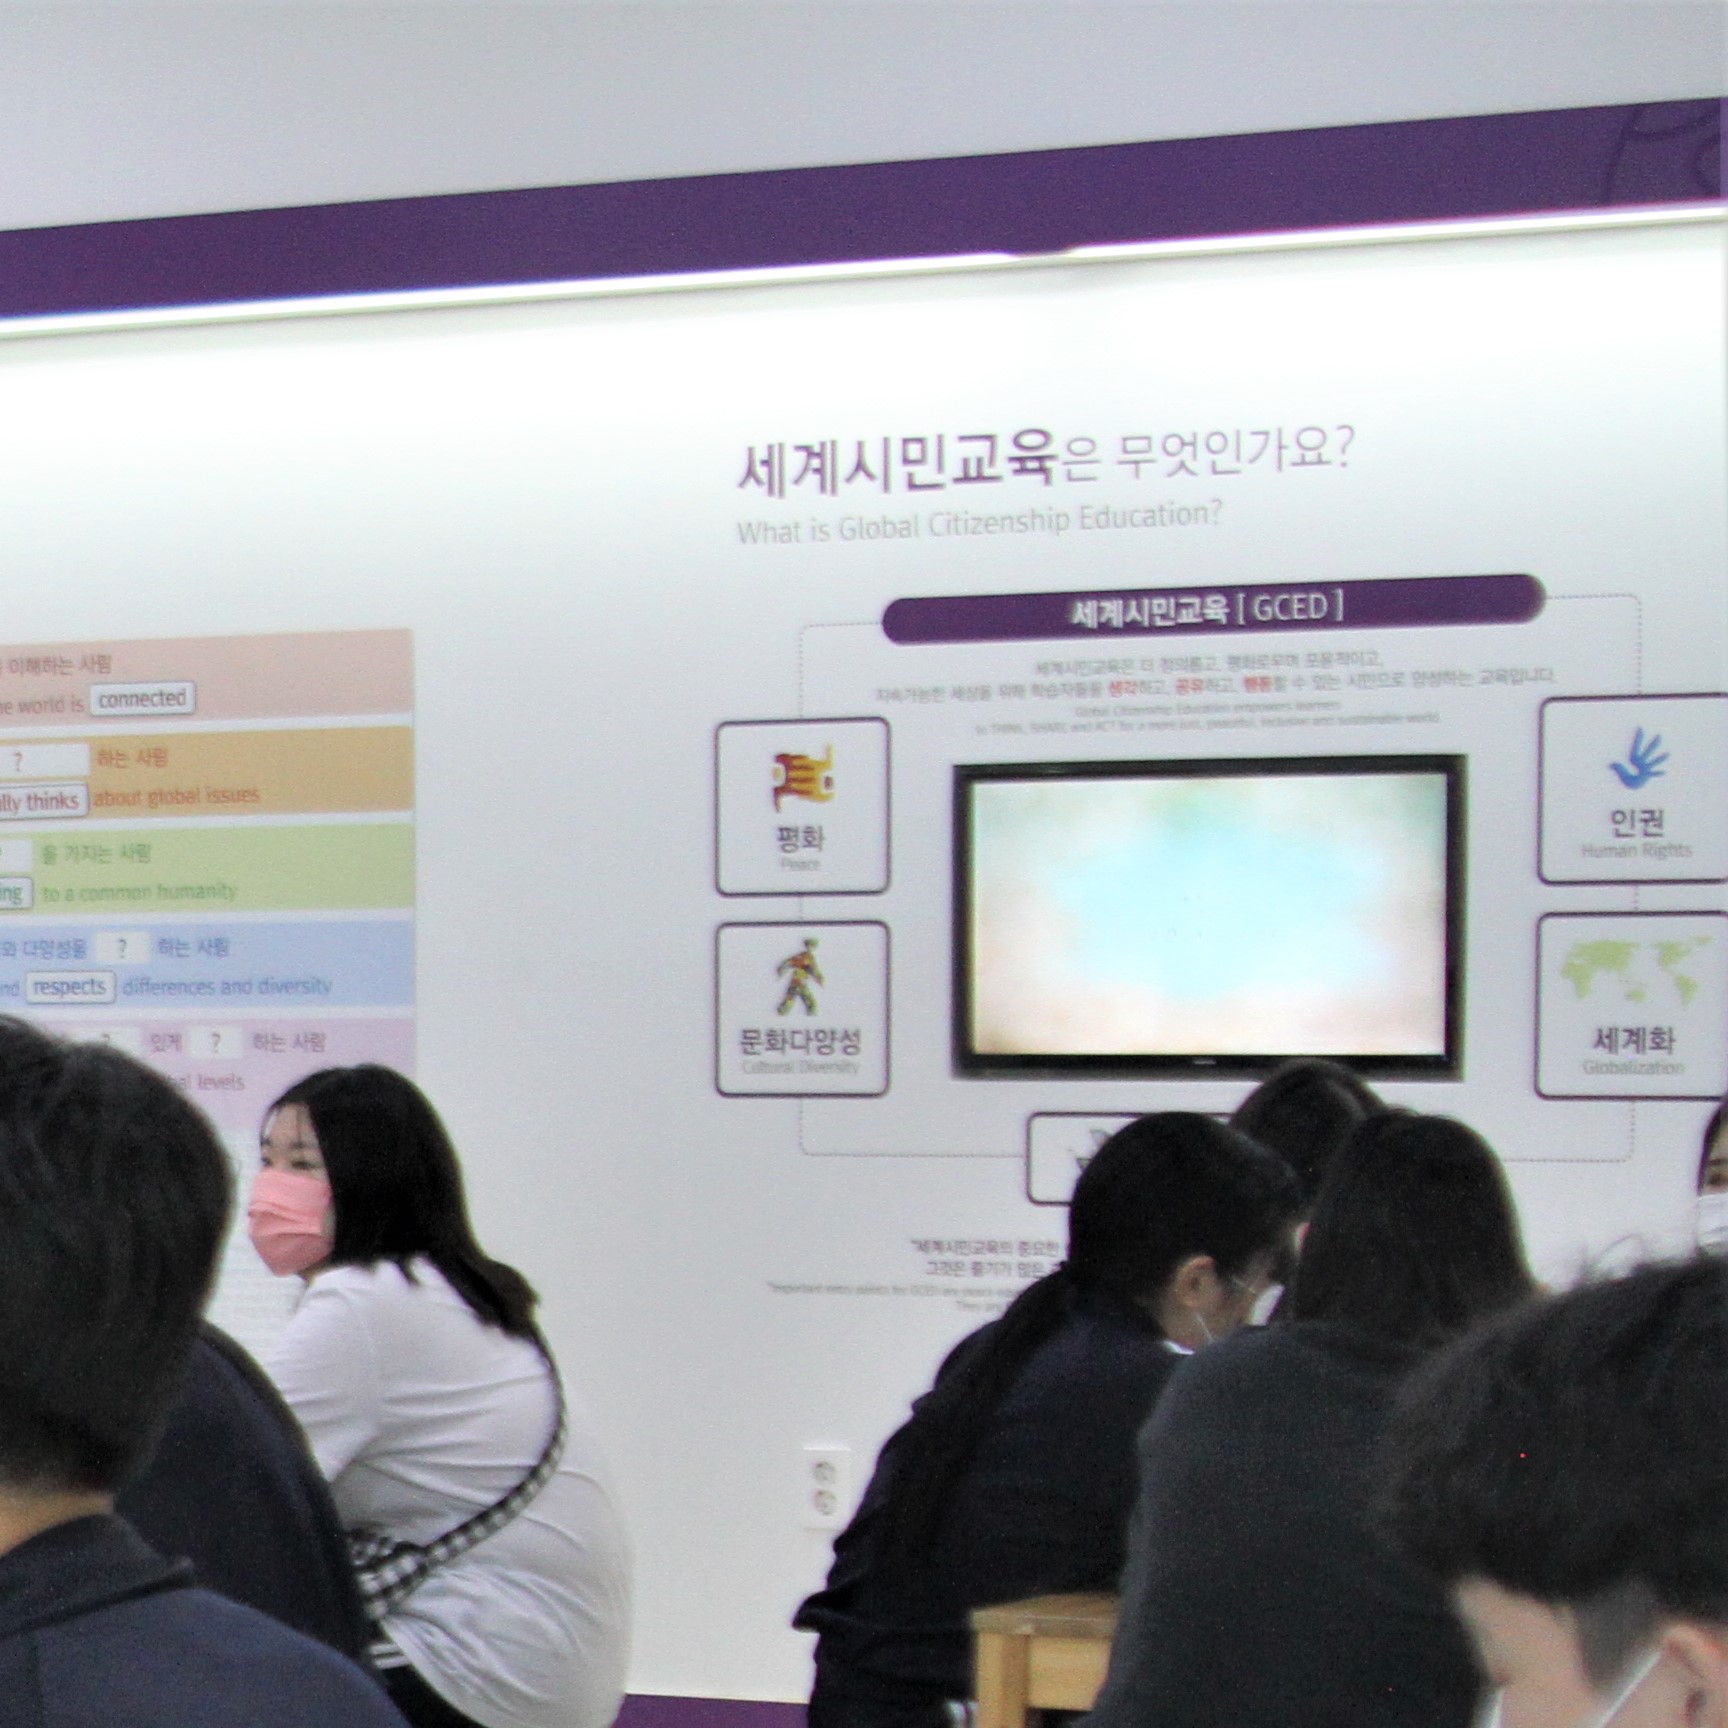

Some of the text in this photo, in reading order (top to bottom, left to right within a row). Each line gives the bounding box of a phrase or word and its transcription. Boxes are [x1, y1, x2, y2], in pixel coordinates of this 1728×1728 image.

[737, 424, 1356, 500] 세계시민교육은 무엇인가요?
[737, 498, 1224, 545] What is Global Citizenship Education?
[1070, 590, 1329, 630] 세계시민교육 GCED
[79, 653, 113, 676] 사람
[16, 694, 65, 715] world
[70, 694, 85, 713] is
[98, 687, 189, 710] connected
[26, 790, 80, 811] thinks
[93, 790, 143, 808] about
[147, 787, 202, 809] global
[206, 786, 262, 805] issues
[1610, 808, 1665, 839] 인권
[776, 824, 826, 854] 평화
[1581, 841, 1694, 861] Human Rights
[78, 885, 154, 902] common
[157, 881, 239, 902] humanity
[33, 977, 107, 998] respects
[122, 976, 217, 998] differences
[219, 975, 254, 996] and
[258, 974, 334, 997] diversity
[252, 1032, 288, 1054] 하는
[291, 1032, 327, 1054] 사람
[740, 1027, 862, 1057] 문화다양성
[1593, 1025, 1677, 1056] 세계화
[798, 1058, 861, 1076] Diversity
[1582, 1058, 1686, 1077] Globalization
[196, 1074, 246, 1092] levels
